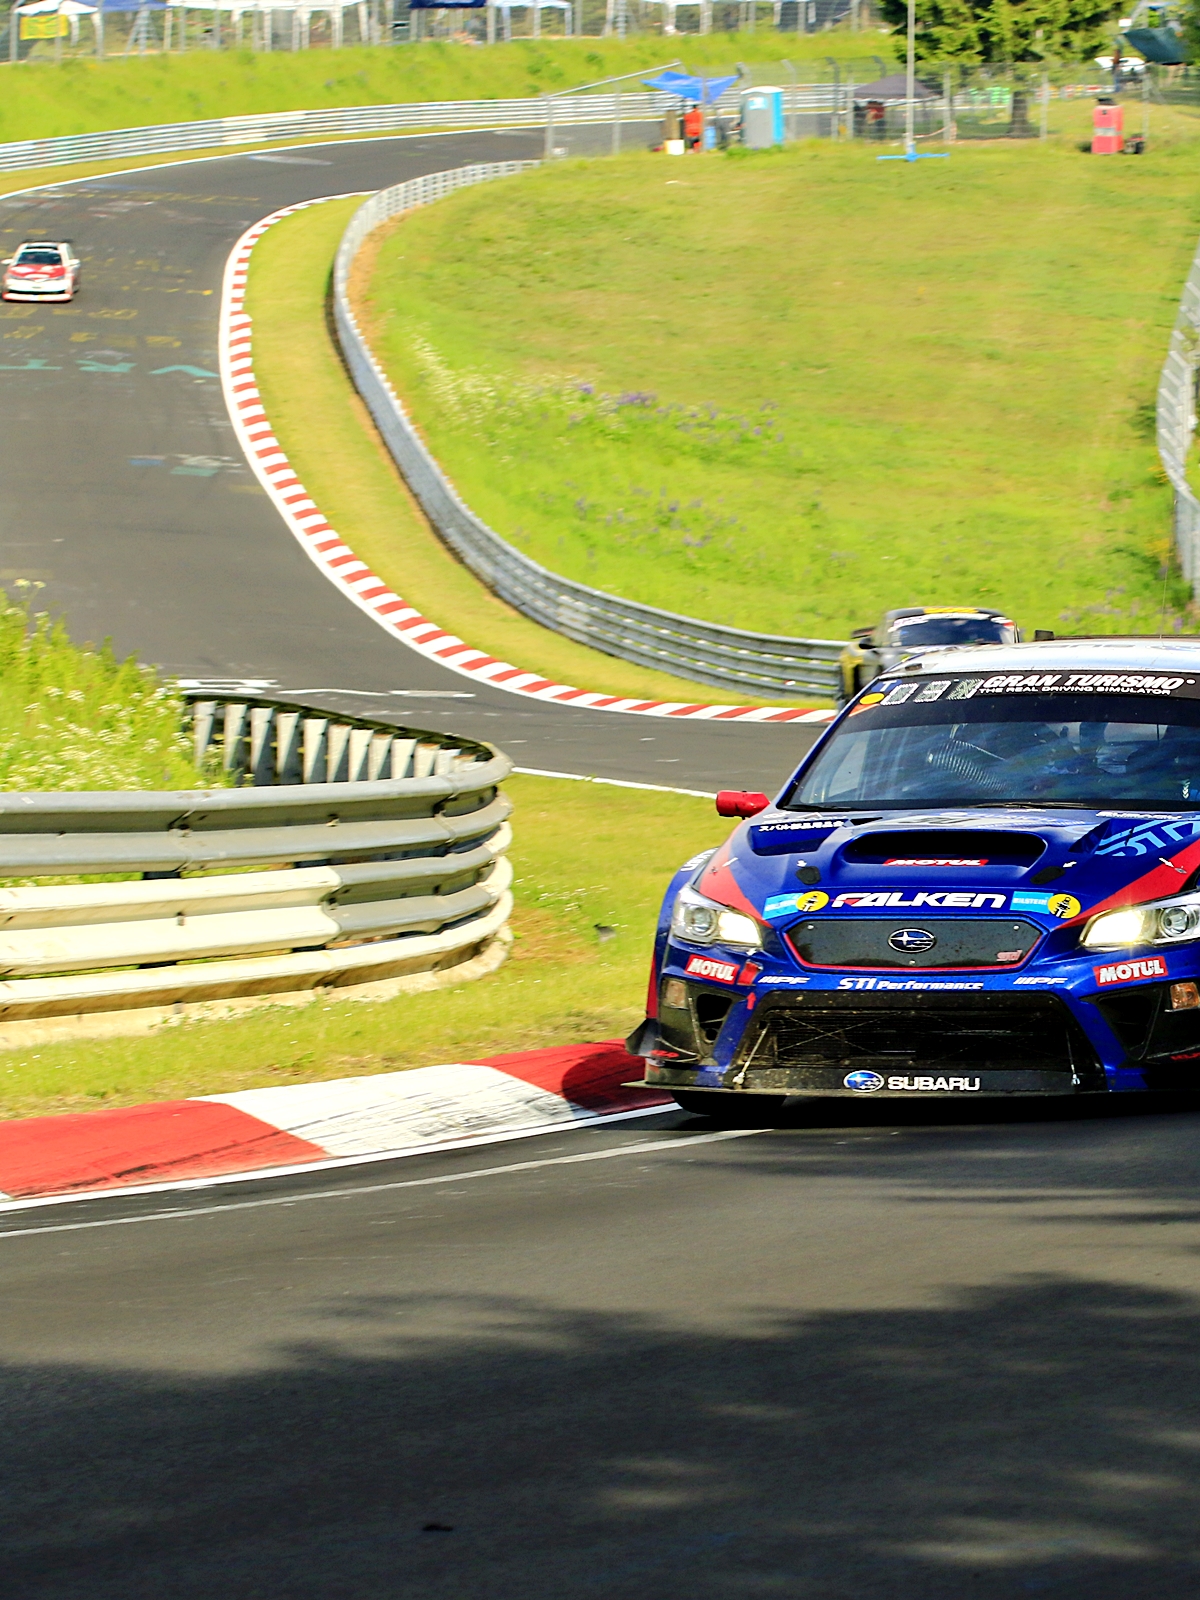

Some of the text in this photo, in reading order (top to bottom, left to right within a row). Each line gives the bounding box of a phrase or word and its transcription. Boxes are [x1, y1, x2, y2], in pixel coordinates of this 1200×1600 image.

[983, 675, 1185, 690] GRAN TURISMO
[1096, 686, 1171, 695] SIMULATOR
[831, 892, 1007, 909] FALKEN
[687, 957, 736, 981] MOTUL
[1099, 959, 1165, 983] MOTUL
[836, 977, 984, 991] STI Performance
[887, 1076, 981, 1091] SUBARU
